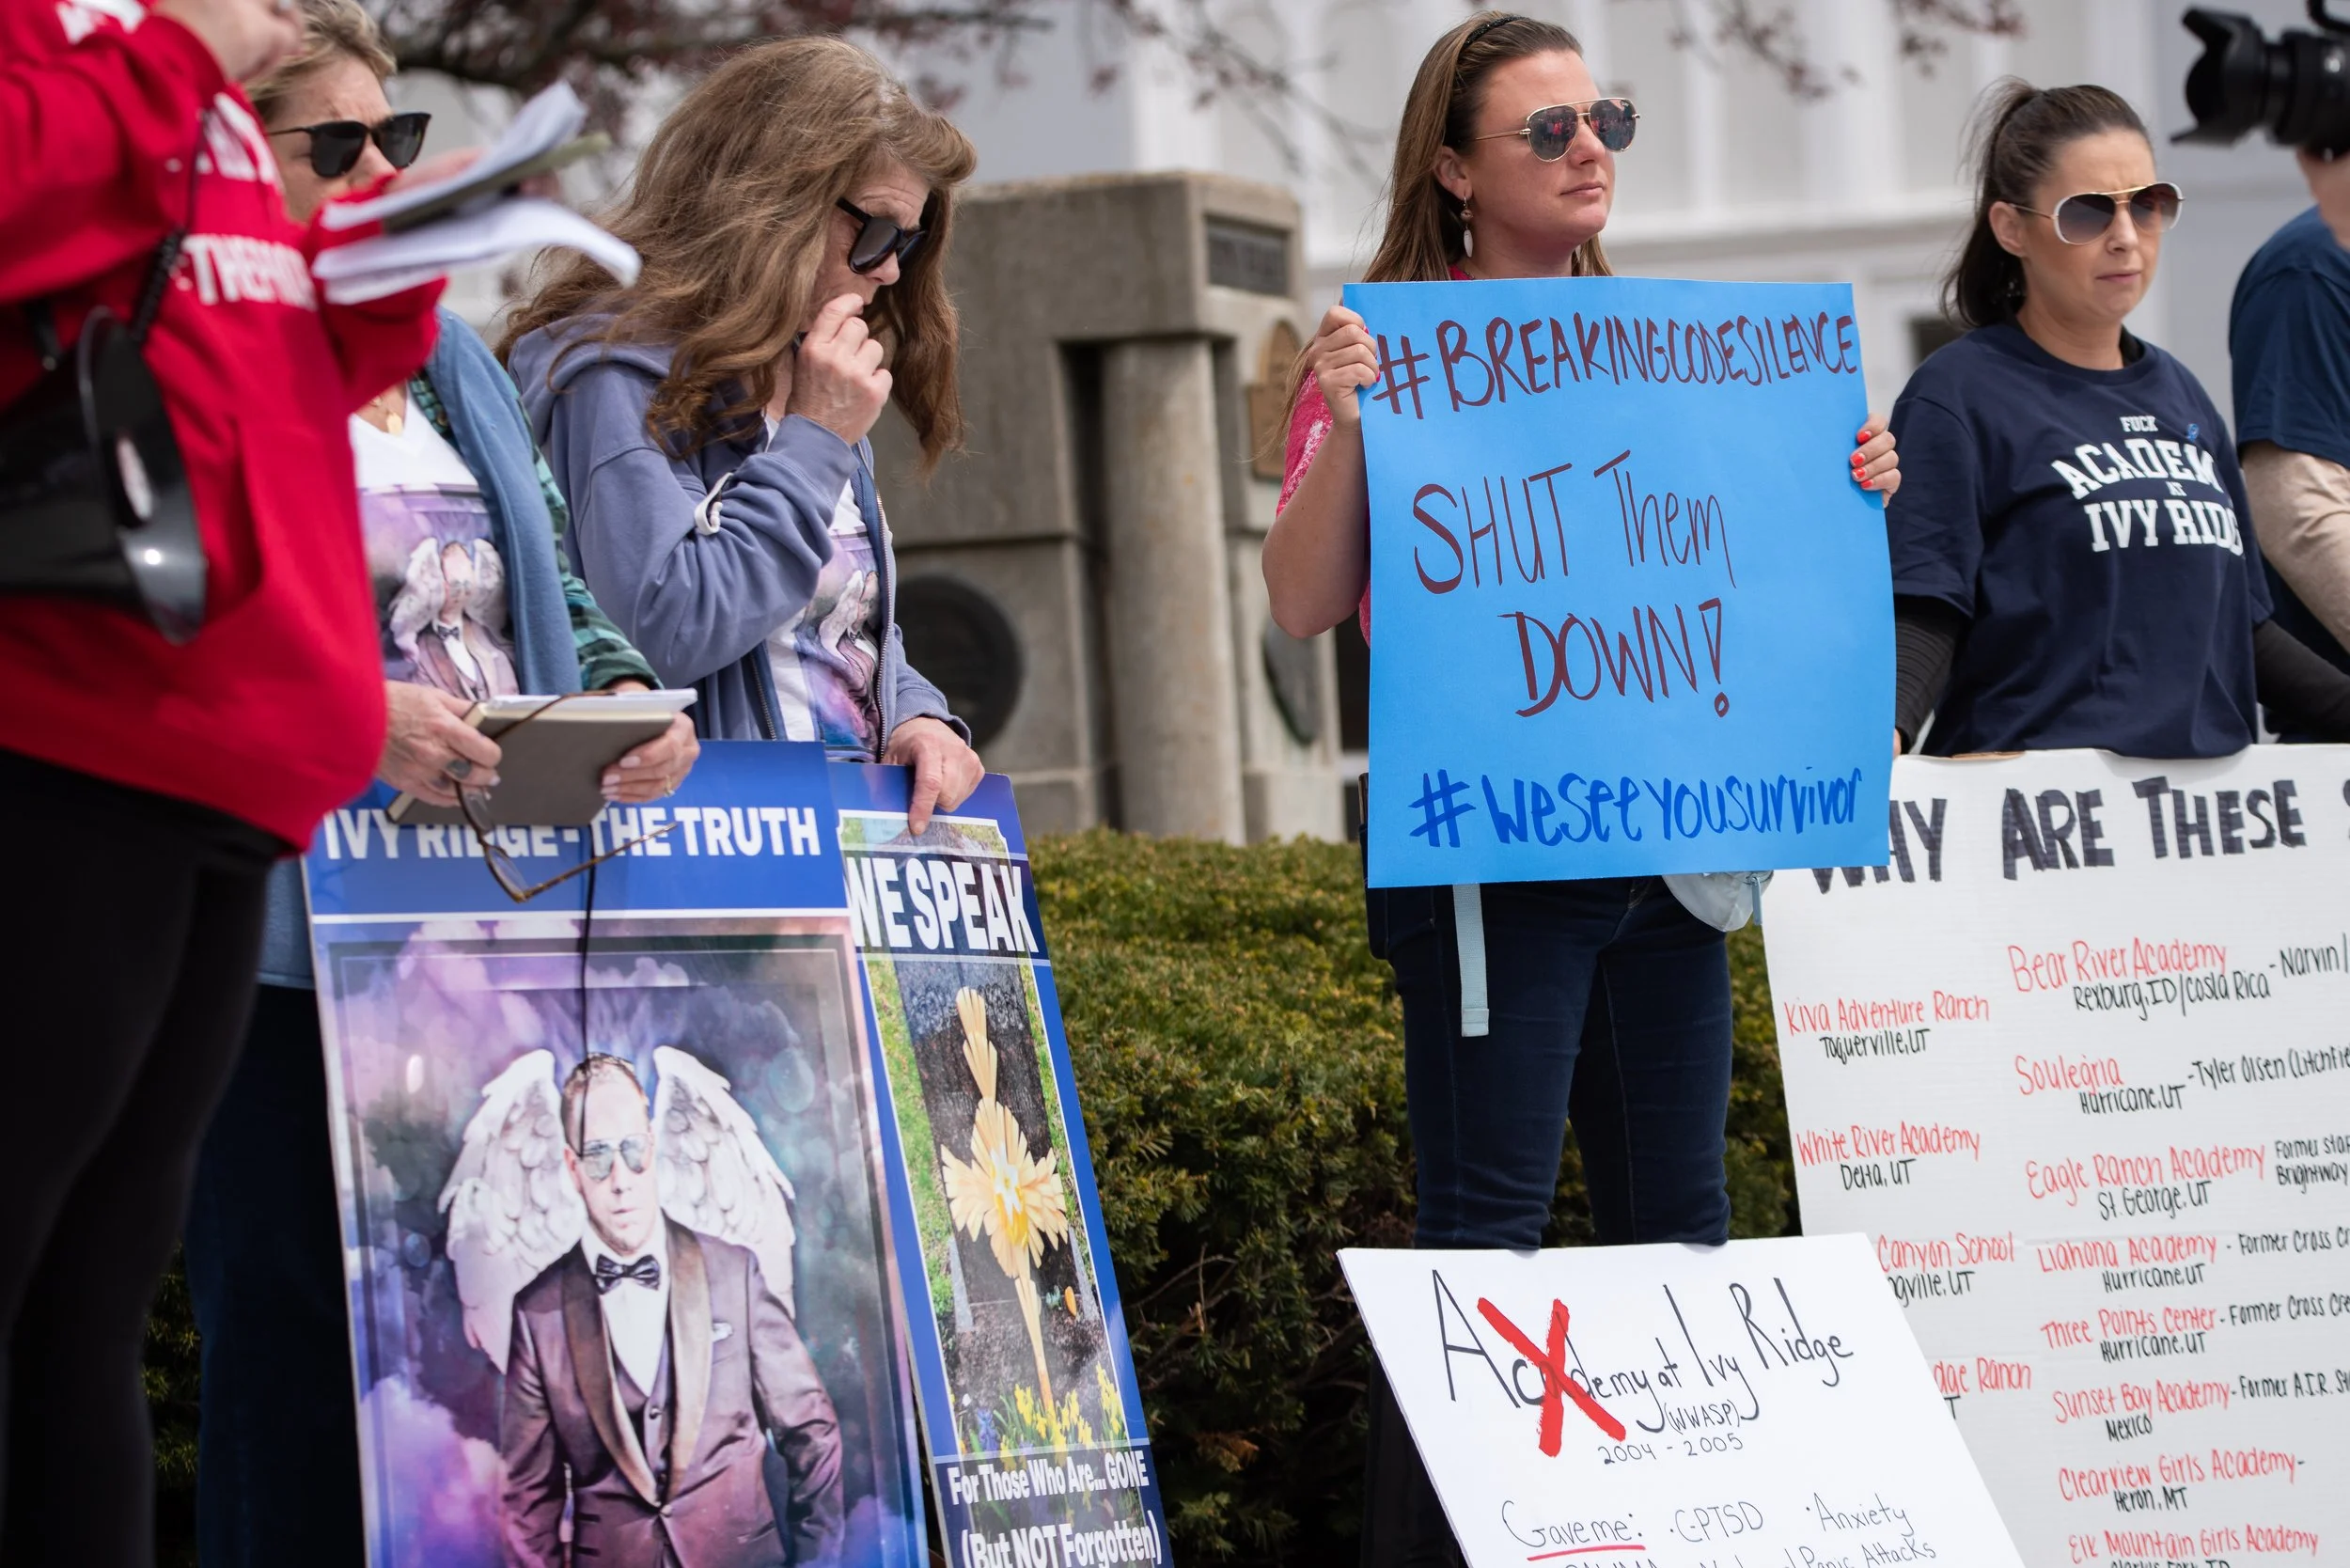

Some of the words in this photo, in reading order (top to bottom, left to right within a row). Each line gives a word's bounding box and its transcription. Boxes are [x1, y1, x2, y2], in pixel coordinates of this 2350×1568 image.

[1372, 312, 1858, 419] #BREAKINGCODESILENCE
[2120, 415, 2158, 432] FUCK
[2166, 480, 2187, 496] AT
[1413, 463, 1573, 594] SHUT
[1594, 449, 1736, 588] Them
[2083, 498, 2158, 553] IVY
[1497, 597, 1731, 717] DOWN!
[322, 808, 400, 859] IVY
[590, 807, 671, 858] THE
[674, 806, 822, 857] TRUTH
[2002, 787, 2115, 881] ARE
[2132, 776, 2308, 859] THESE
[843, 856, 912, 949] WE
[905, 857, 1039, 953] SPEAK
[2008, 945, 2068, 993] Bear
[2073, 939, 2127, 982] River
[2132, 936, 2227, 980] Academy
[2232, 969, 2272, 1002] Rica
[1784, 996, 1832, 1036] Kiva
[1837, 997, 1925, 1033] Adventure
[1933, 990, 1991, 1023] Ranch
[2241, 1054, 2286, 1084] Olsen
[1796, 1127, 1850, 1168] White
[1851, 1123, 1896, 1158] River
[1899, 1120, 1981, 1162] Academy
[2275, 1139, 2320, 1160] Former
[1889, 1157, 1917, 1185] UT
[2025, 1159, 2091, 1208] Eagle
[2092, 1152, 2164, 1188] Ranch
[2168, 1144, 2265, 1182] Academy
[1877, 1233, 1952, 1274] Canyon
[2037, 1238, 2120, 1273] Liahona
[2126, 1232, 2217, 1264] Academy
[2237, 1232, 2289, 1256] Former
[2293, 1229, 2332, 1253] Cross
[1654, 1336, 1682, 1388] at
[1728, 1277, 1855, 1388] Ridge
[2039, 1319, 2094, 1350] Three
[2097, 1306, 2158, 1339] Points
[2163, 1306, 2217, 1336] Center
[2229, 1301, 2282, 1326] Former
[2287, 1294, 2326, 1320] Cross
[1975, 1356, 2032, 1394] Ranch
[2052, 1386, 2116, 1424] Sunset
[2120, 1382, 2154, 1419] Bay
[2154, 1377, 2230, 1415] Academy
[2238, 1373, 2289, 1400] Former
[1663, 1398, 1741, 1435] (WWASP)
[2105, 1412, 2154, 1442] Mexico
[1597, 1442, 1655, 1465] 2004
[1683, 1432, 1745, 1457] 2005
[947, 1466, 979, 1506] For
[978, 1463, 1030, 1501] Those
[1026, 1457, 1066, 1497] Who
[1066, 1455, 1107, 1495] Are...
[1104, 1450, 1150, 1490] GONE
[2059, 1460, 2153, 1502] Clearview
[2157, 1452, 2206, 1485] Girls
[961, 1529, 1012, 1568] (But
[1010, 1524, 1059, 1568] NOT
[1058, 1510, 1163, 1568] Forgotten)
[2103, 1529, 2196, 1561] Mountain
[2200, 1525, 2242, 1557] Girls
[2245, 1522, 2319, 1559] Academy
